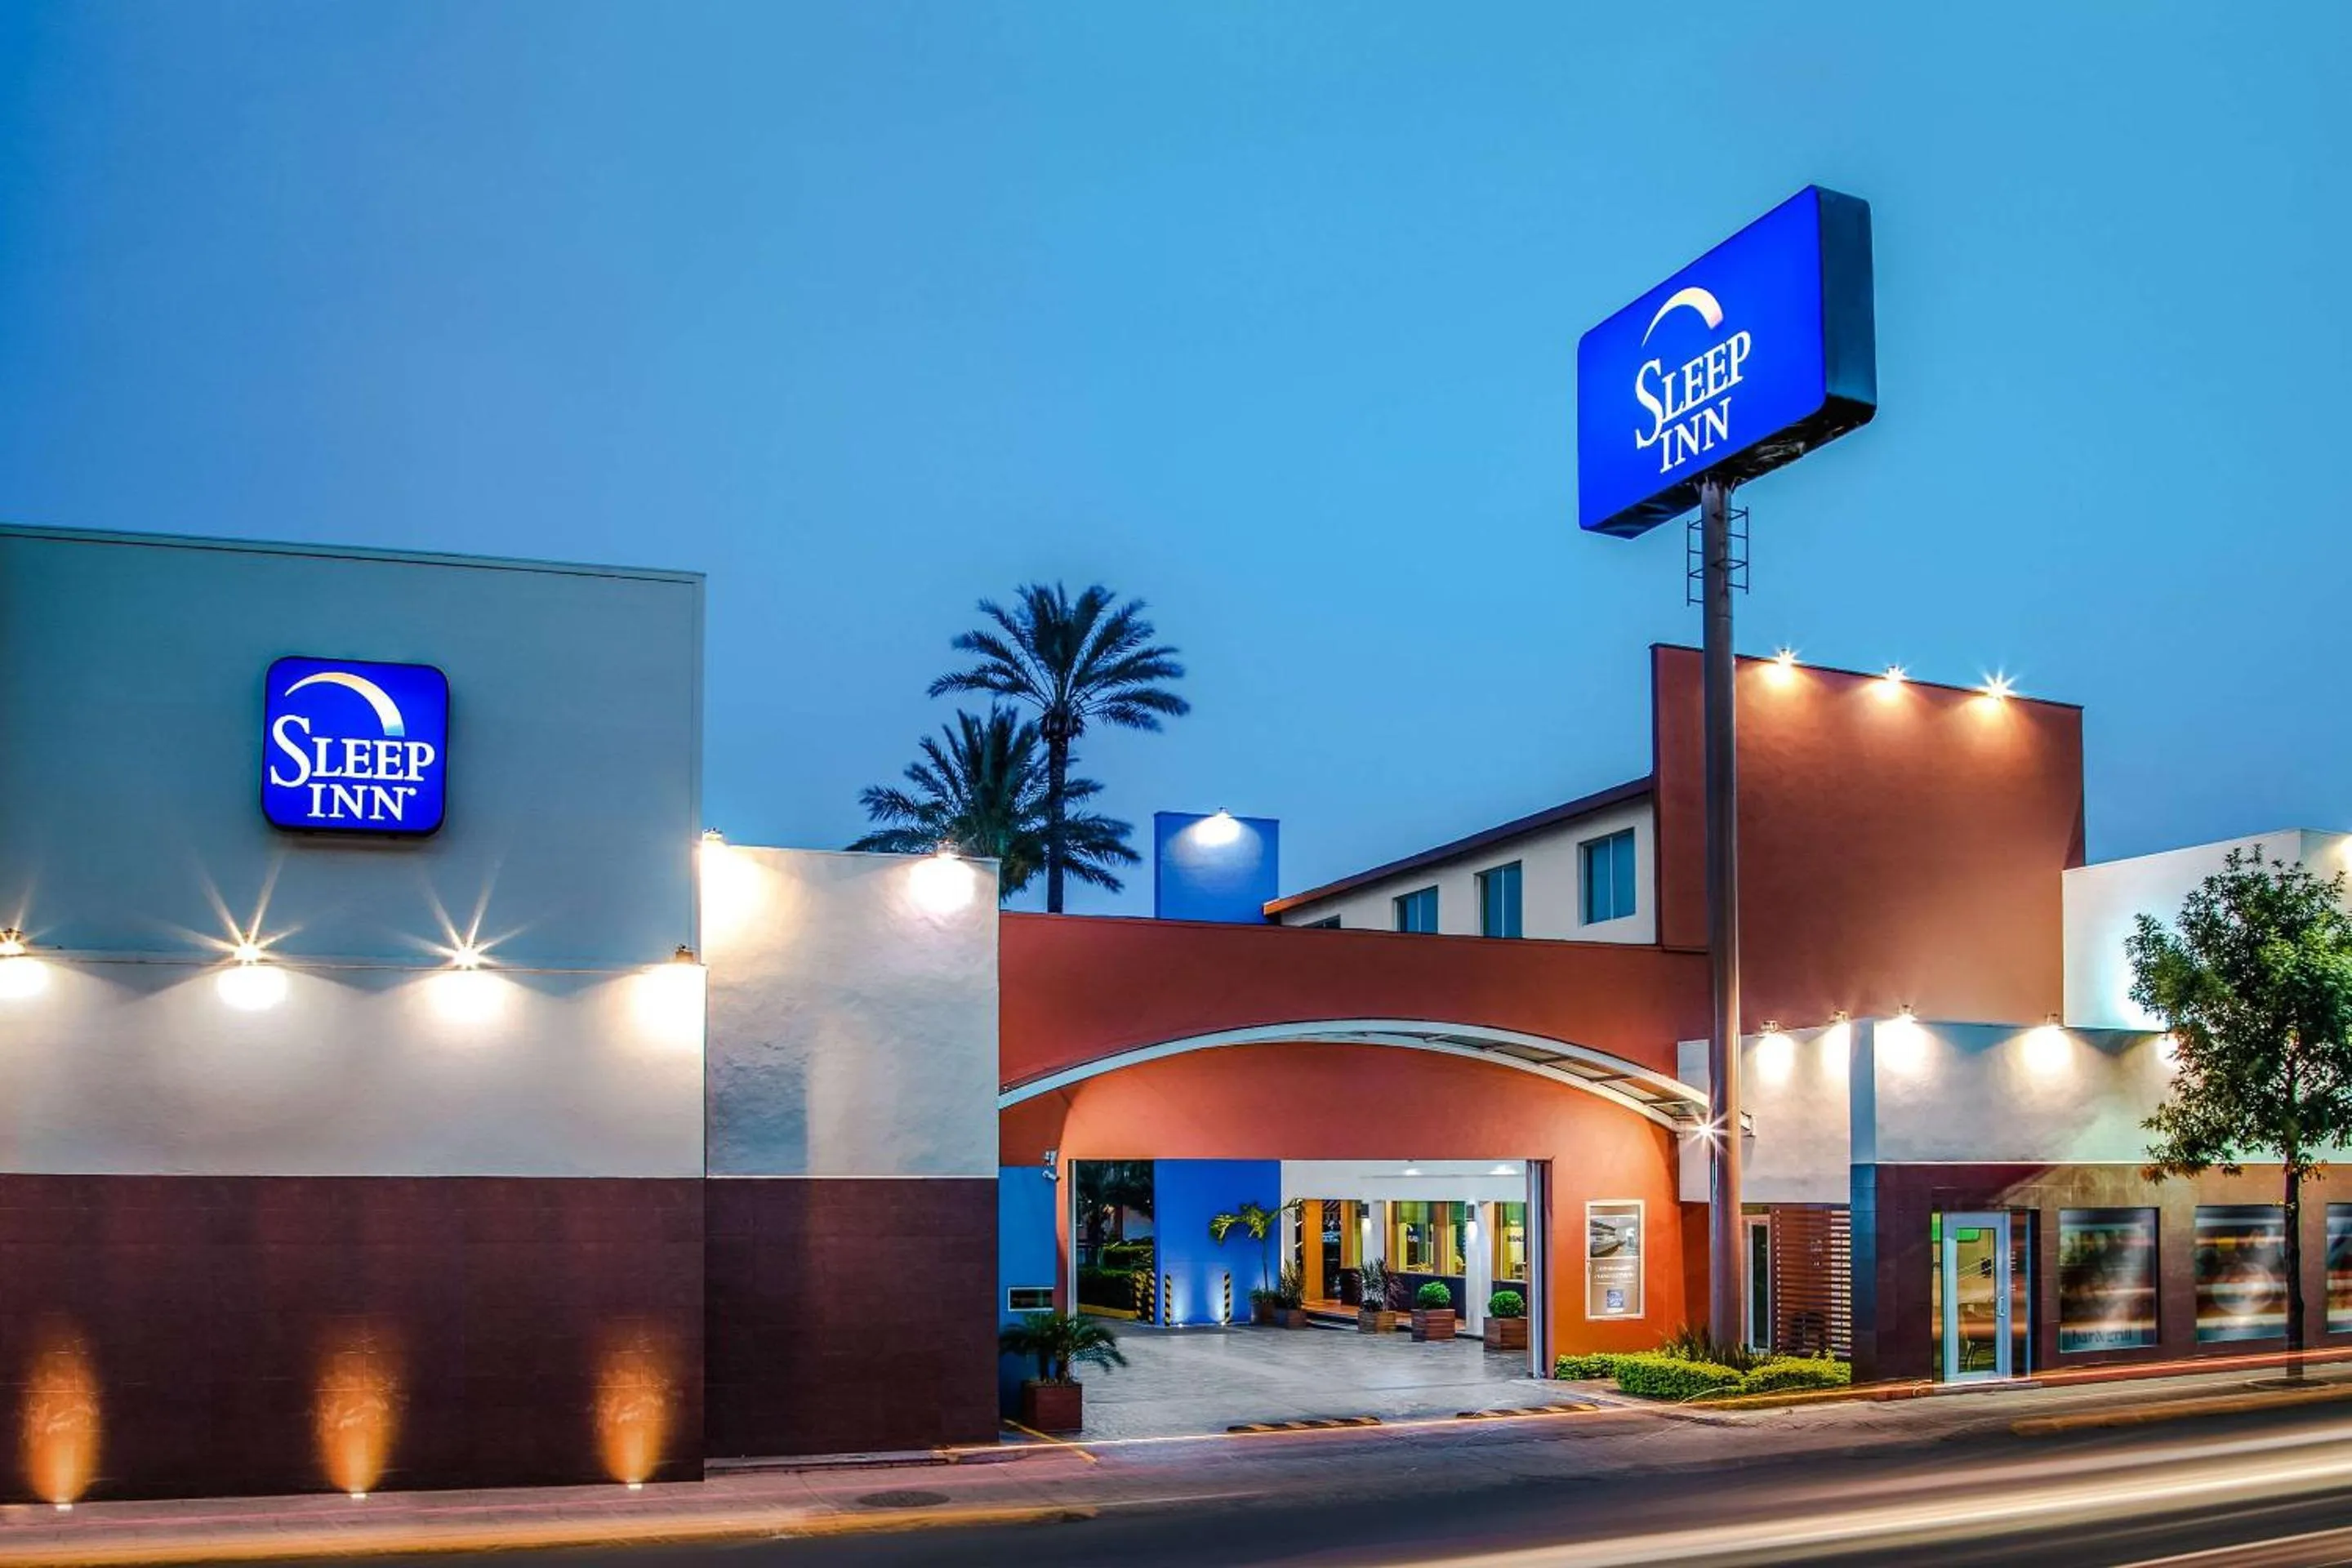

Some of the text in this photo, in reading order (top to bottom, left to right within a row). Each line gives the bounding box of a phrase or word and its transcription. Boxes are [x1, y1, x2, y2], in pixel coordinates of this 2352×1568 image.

[1635, 331, 1751, 448] SLEEP
[1659, 397, 1731, 474] INN
[270, 715, 435, 788] SLEEP
